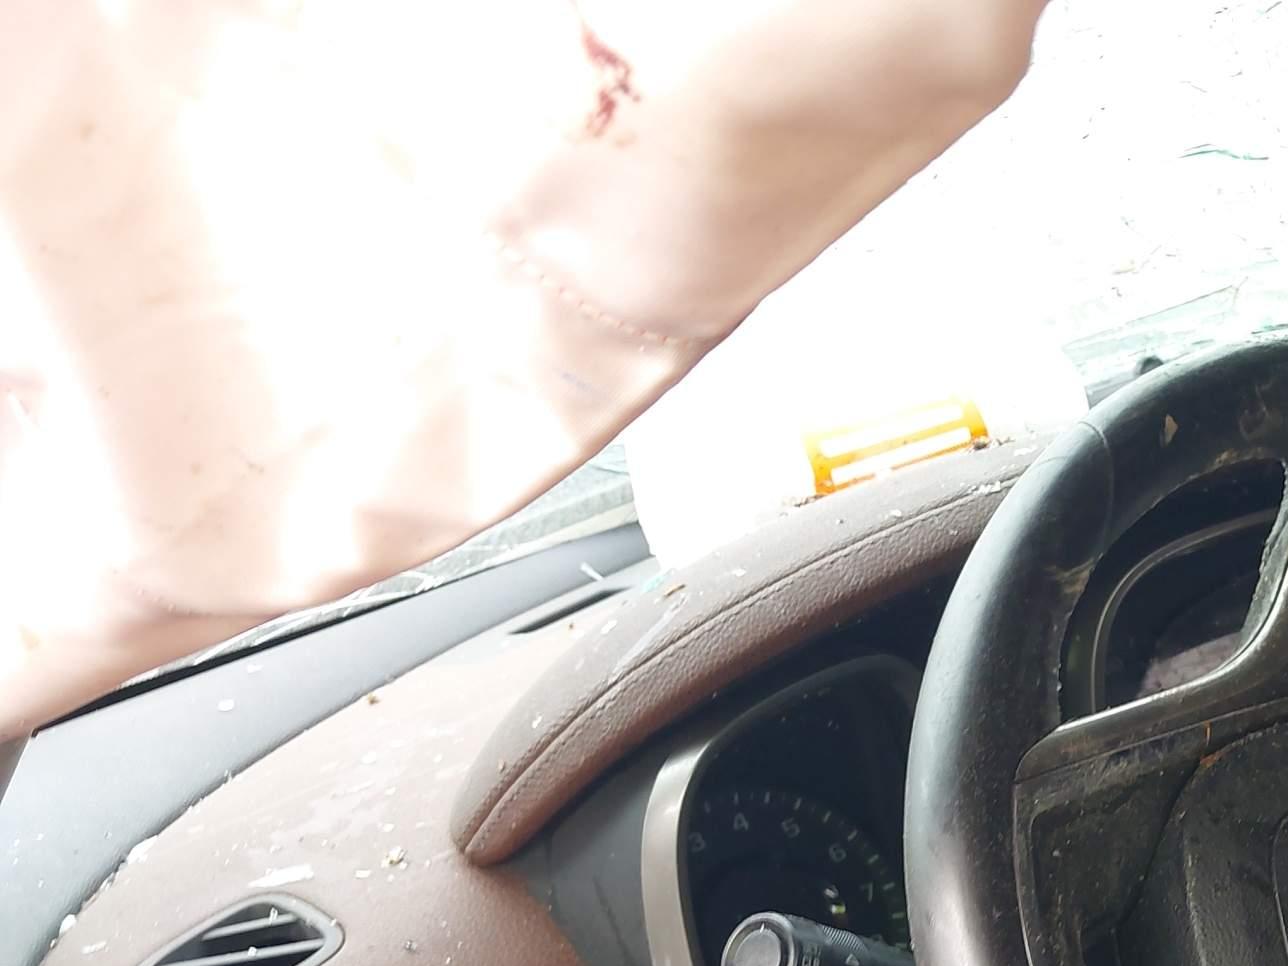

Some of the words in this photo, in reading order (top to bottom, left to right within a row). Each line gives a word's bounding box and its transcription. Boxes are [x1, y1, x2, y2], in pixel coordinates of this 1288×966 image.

[733, 812, 749, 832] 4
[781, 816, 801, 838] 5
[828, 842, 847, 863] 6
